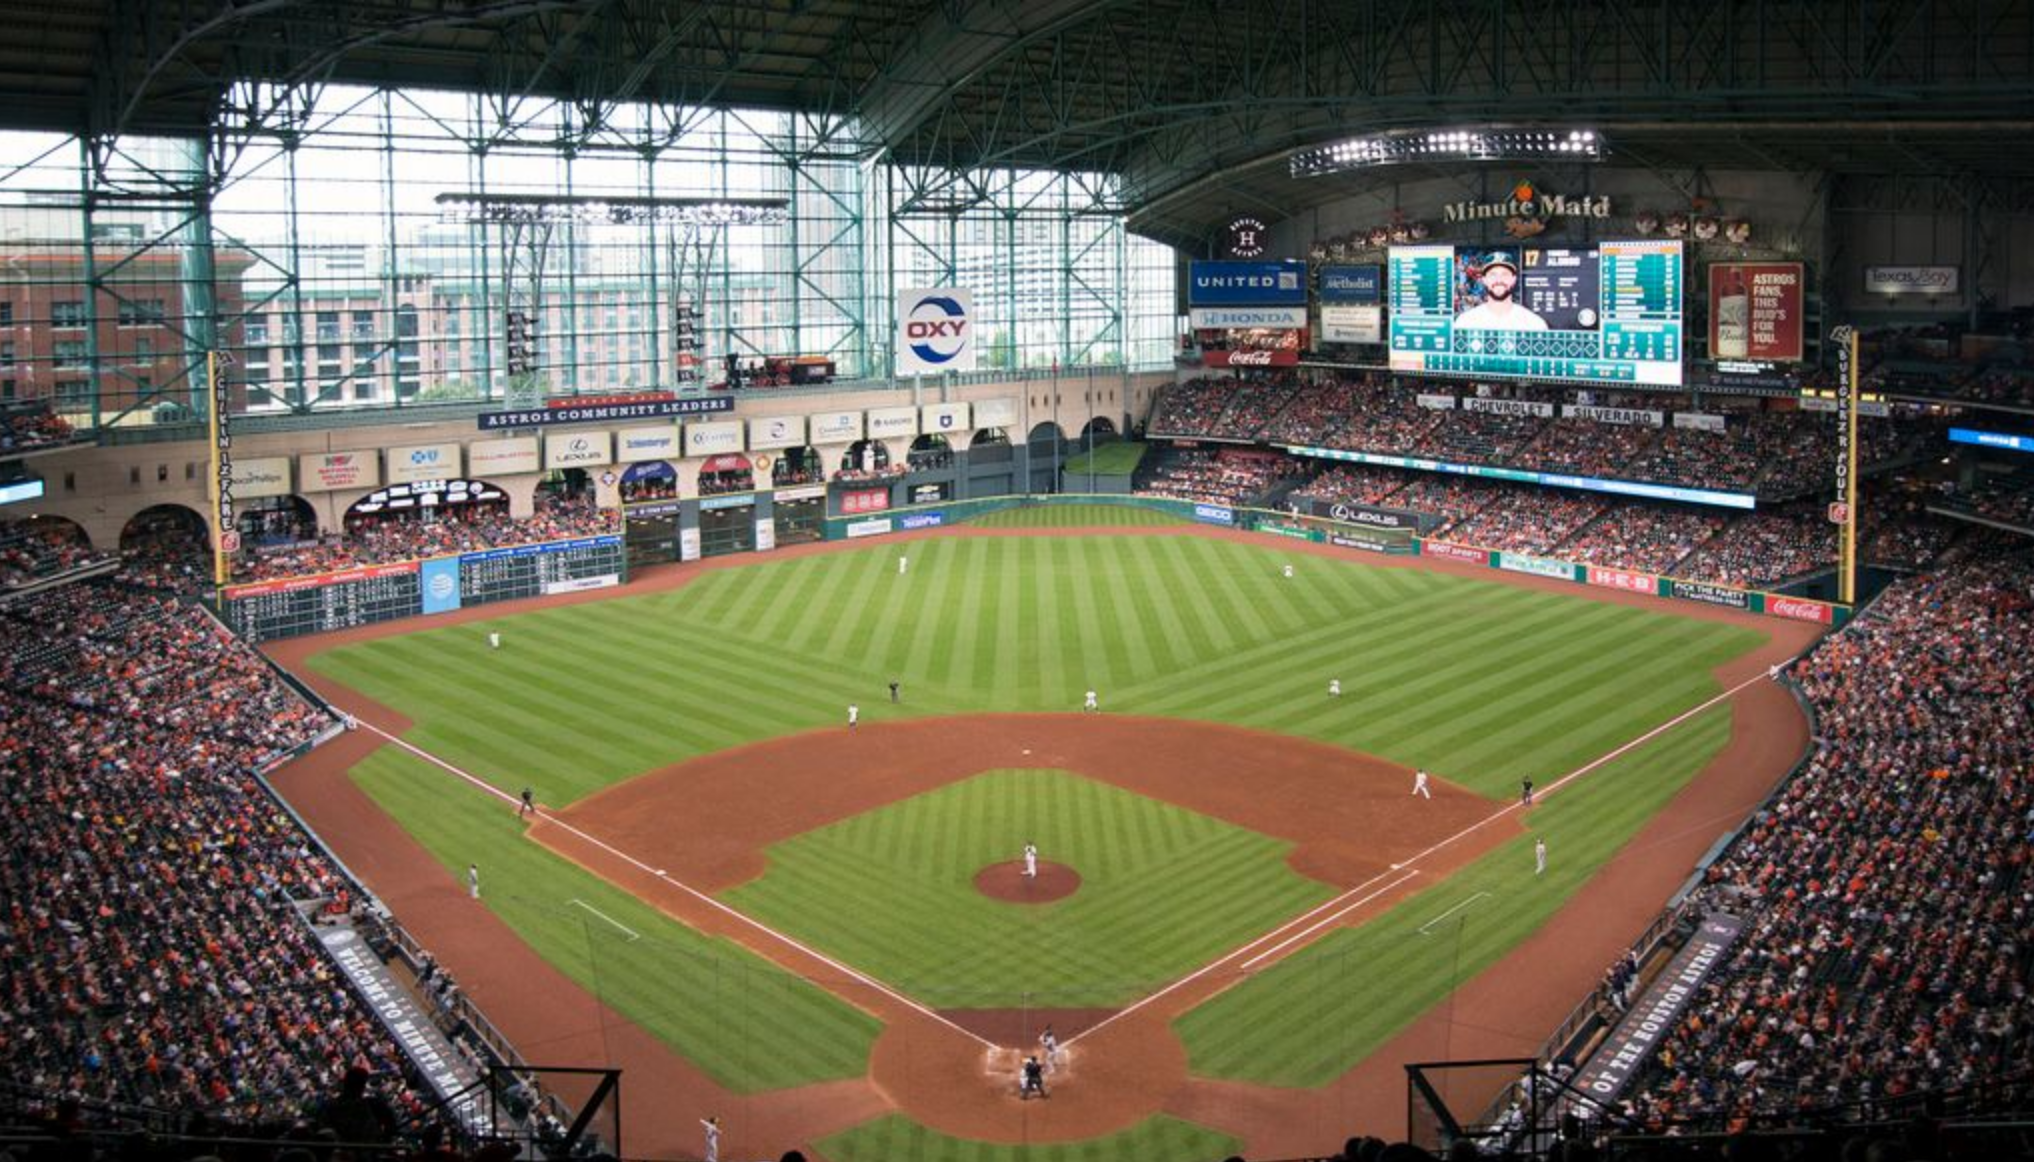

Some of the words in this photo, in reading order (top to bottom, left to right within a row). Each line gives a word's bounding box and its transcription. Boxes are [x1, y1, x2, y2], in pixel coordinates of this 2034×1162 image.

[1443, 199, 1533, 223] Minute
[1540, 195, 1611, 218] Maid
[1240, 231, 1255, 246] H
[1525, 250, 1539, 266] 17
[1197, 277, 1274, 287] UNITED
[1753, 274, 1796, 285] ASTROS
[1753, 285, 1785, 298] FANS,
[1753, 298, 1778, 308] THIS
[1221, 313, 1295, 324] HONDA
[1753, 310, 1787, 320] BUD'S
[907, 319, 967, 338] OXY
[1753, 321, 1775, 331] FOR
[1753, 333, 1779, 344] YOU.
[1228, 351, 1272, 365] Coca-Cola
[488, 412, 551, 426] ASTROS
[557, 405, 657, 420] COMMUNITY
[662, 400, 727, 413] LEADERS
[1471, 400, 1544, 415] CHEVROLET
[1573, 407, 1651, 424] SILVERADO
[555, 452, 602, 462] LEXUS
[1836, 452, 1848, 501] FOUL
[1350, 511, 1399, 526] LEXUS
[1697, 585, 1713, 595] THE
[1715, 588, 1744, 600] PARTY
[1773, 599, 1822, 620] Coca-Cola
[337, 947, 390, 1002] WELCOME
[379, 1001, 403, 1019] TO
[394, 1020, 446, 1072] MINUTE
[1592, 1071, 1620, 1093] OF
[1609, 1042, 1645, 1070] THE
[1634, 983, 1689, 1042] HOUSTON
[1679, 942, 1722, 984] ASTROS
